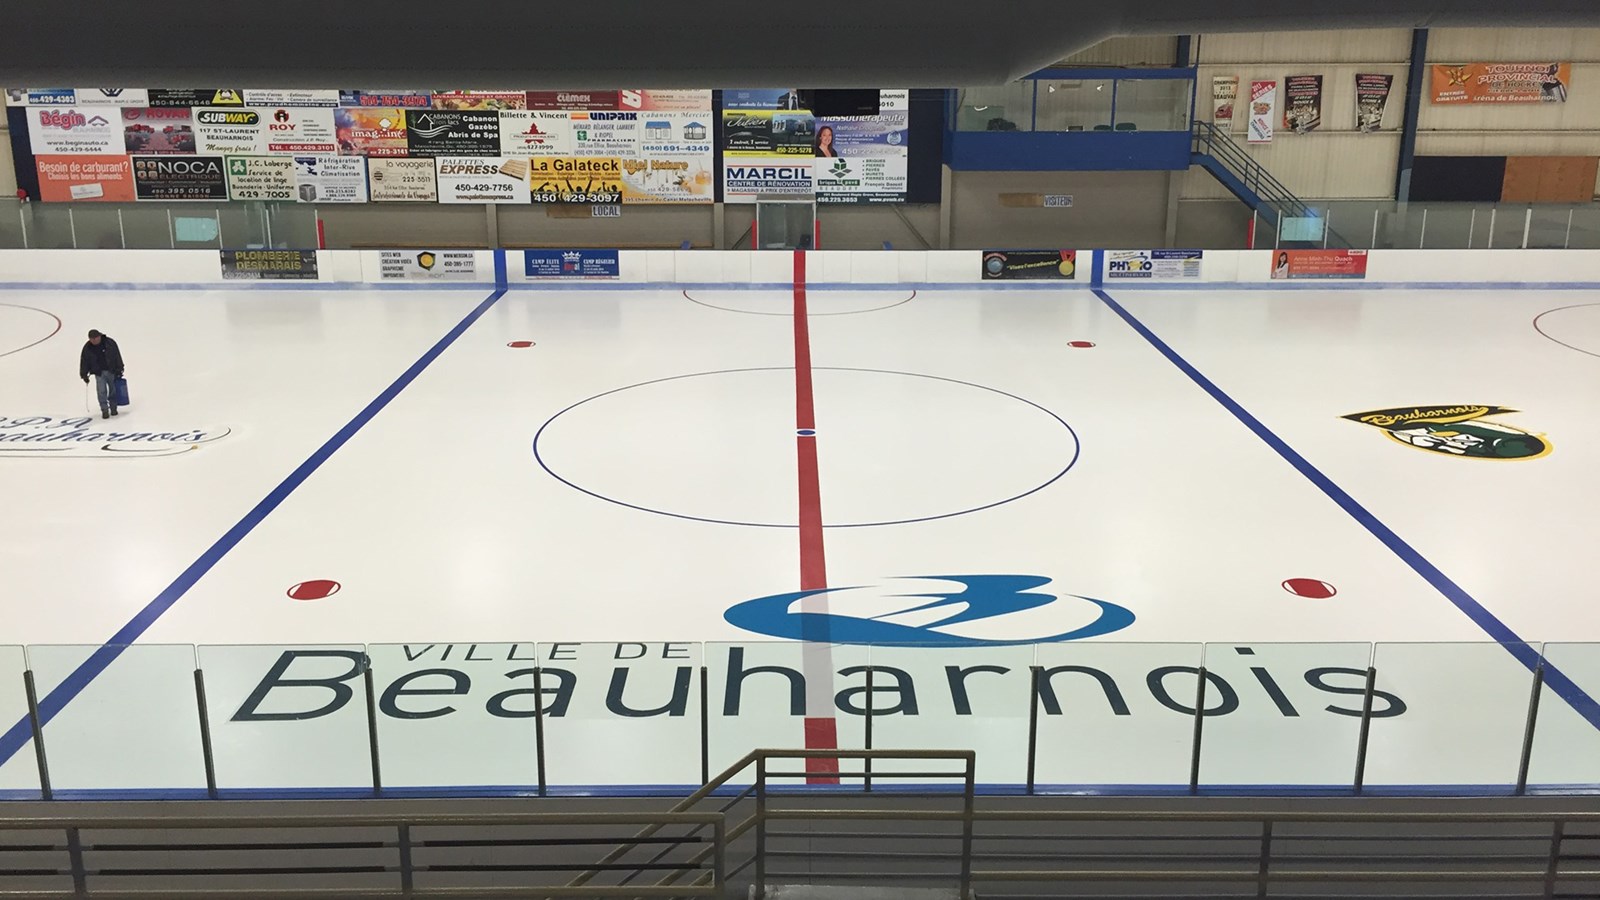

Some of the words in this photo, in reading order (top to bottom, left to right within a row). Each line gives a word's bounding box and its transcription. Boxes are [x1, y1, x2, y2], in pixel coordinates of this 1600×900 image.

[1487, 64, 1552, 74] TOURNOI
[1477, 73, 1557, 84] PROVINCIAL
[40, 109, 86, 130] Bégin
[201, 112, 256, 123] SUBWAY
[590, 112, 638, 120] UNIPRIX
[40, 161, 68, 172] Besoin
[69, 162, 80, 172] de
[158, 161, 220, 174] NOCA
[440, 165, 499, 174] EXPRESS
[530, 159, 548, 171] La
[553, 159, 619, 171] Galateck
[726, 168, 812, 179] MARCIL
[534, 193, 557, 202] 450
[563, 193, 619, 202] 429-3097
[592, 205, 619, 216] LOCAL
[235, 251, 301, 260] PLOMBERIE
[236, 262, 302, 270] DESMARAIS
[1361, 405, 1485, 425] Beauharnois
[402, 642, 580, 661] VILLE
[613, 642, 692, 660] DE
[230, 646, 1408, 721] Beauharnois
